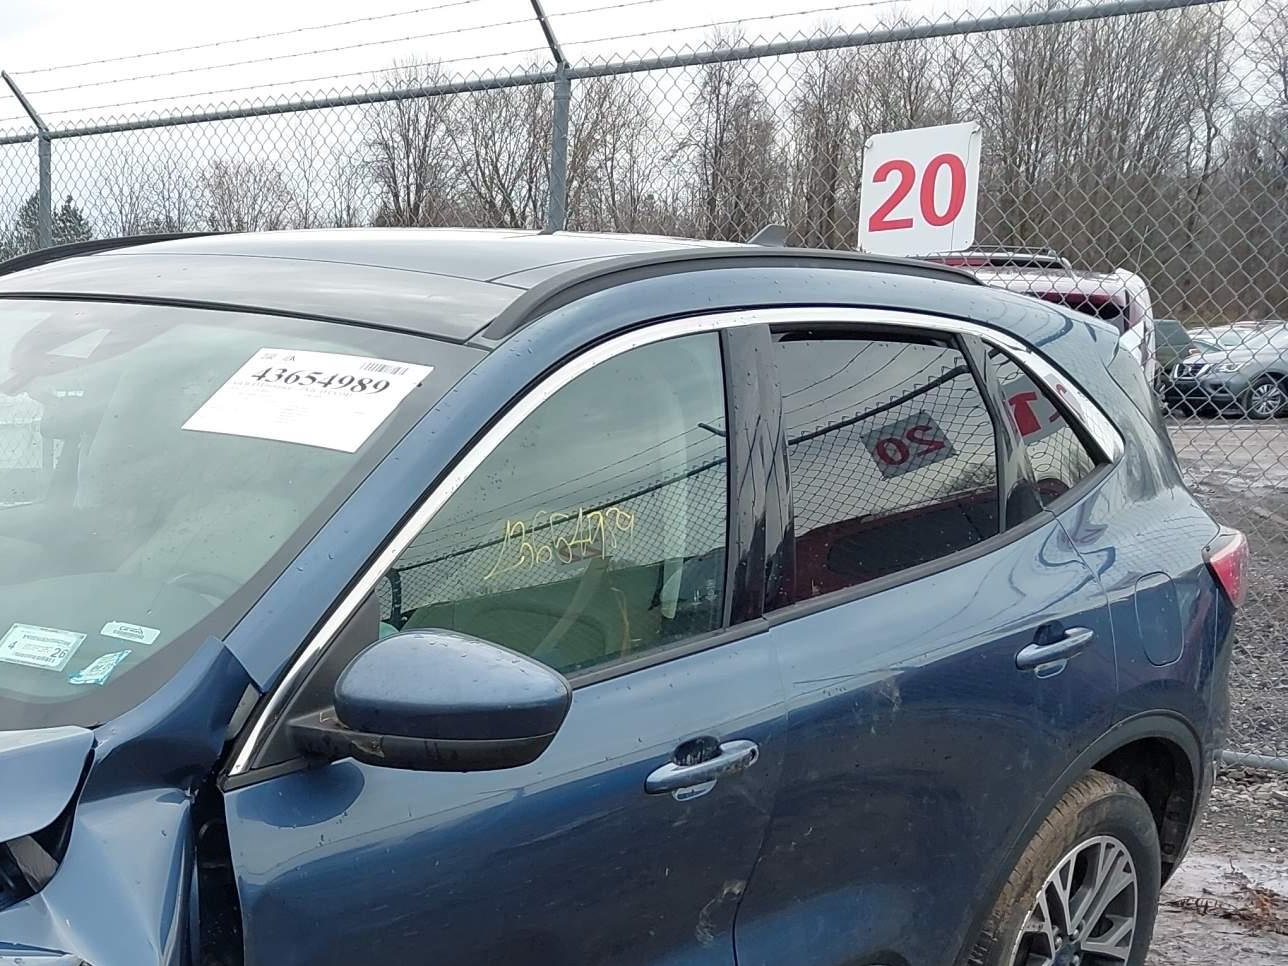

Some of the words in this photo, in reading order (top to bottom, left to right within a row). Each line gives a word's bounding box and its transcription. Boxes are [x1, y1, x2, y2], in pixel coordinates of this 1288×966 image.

[869, 153, 967, 232] 20
[251, 367, 392, 395] 43654989
[50, 647, 69, 659] 26
